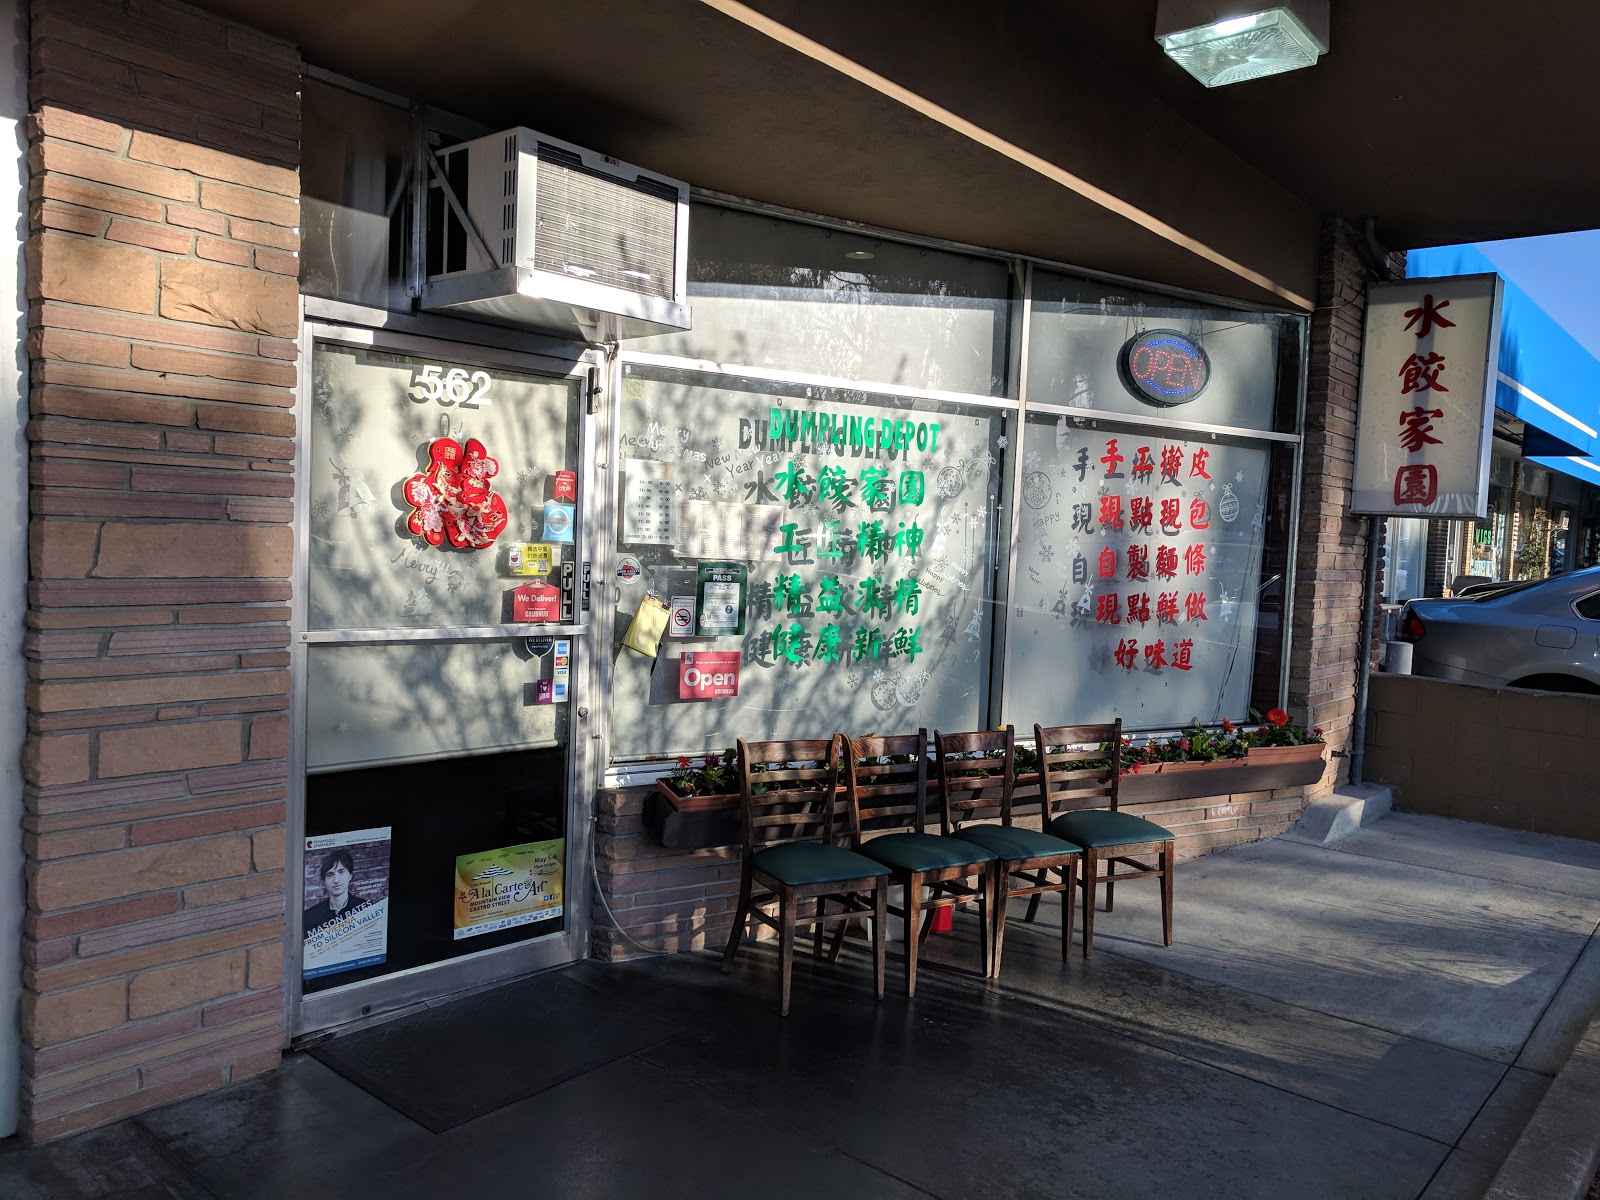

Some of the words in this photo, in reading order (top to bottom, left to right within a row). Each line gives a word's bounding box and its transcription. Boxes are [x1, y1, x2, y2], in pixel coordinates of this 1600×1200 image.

[421, 364, 492, 405] 562
[1133, 346, 1203, 389] OPEN
[1393, 293, 1457, 507] 水餃家園
[769, 407, 875, 448] DUMPLING
[881, 418, 940, 453] DEPOT
[1098, 494, 1210, 530] 現點現包
[517, 594, 529, 602] We
[531, 594, 557, 602] Deliver!
[562, 563, 573, 618] PULL
[772, 573, 923, 616] 精益求精
[1095, 590, 1208, 625] 現點鮮做
[771, 622, 923, 663] 健康新鮮
[1114, 638, 1194, 671] 好味道
[684, 668, 735, 691] Open
[470, 897, 497, 906] MOUNTAIN
[494, 882, 523, 895] Carte
[307, 914, 344, 938] MASON
[345, 899, 374, 917] BATES
[470, 904, 491, 912] CASTRO
[303, 933, 324, 947] FROM
[325, 916, 357, 935] VIENNA
[312, 941, 323, 950] TO
[324, 922, 356, 944] SILICON
[357, 907, 385, 926] VALLEY
